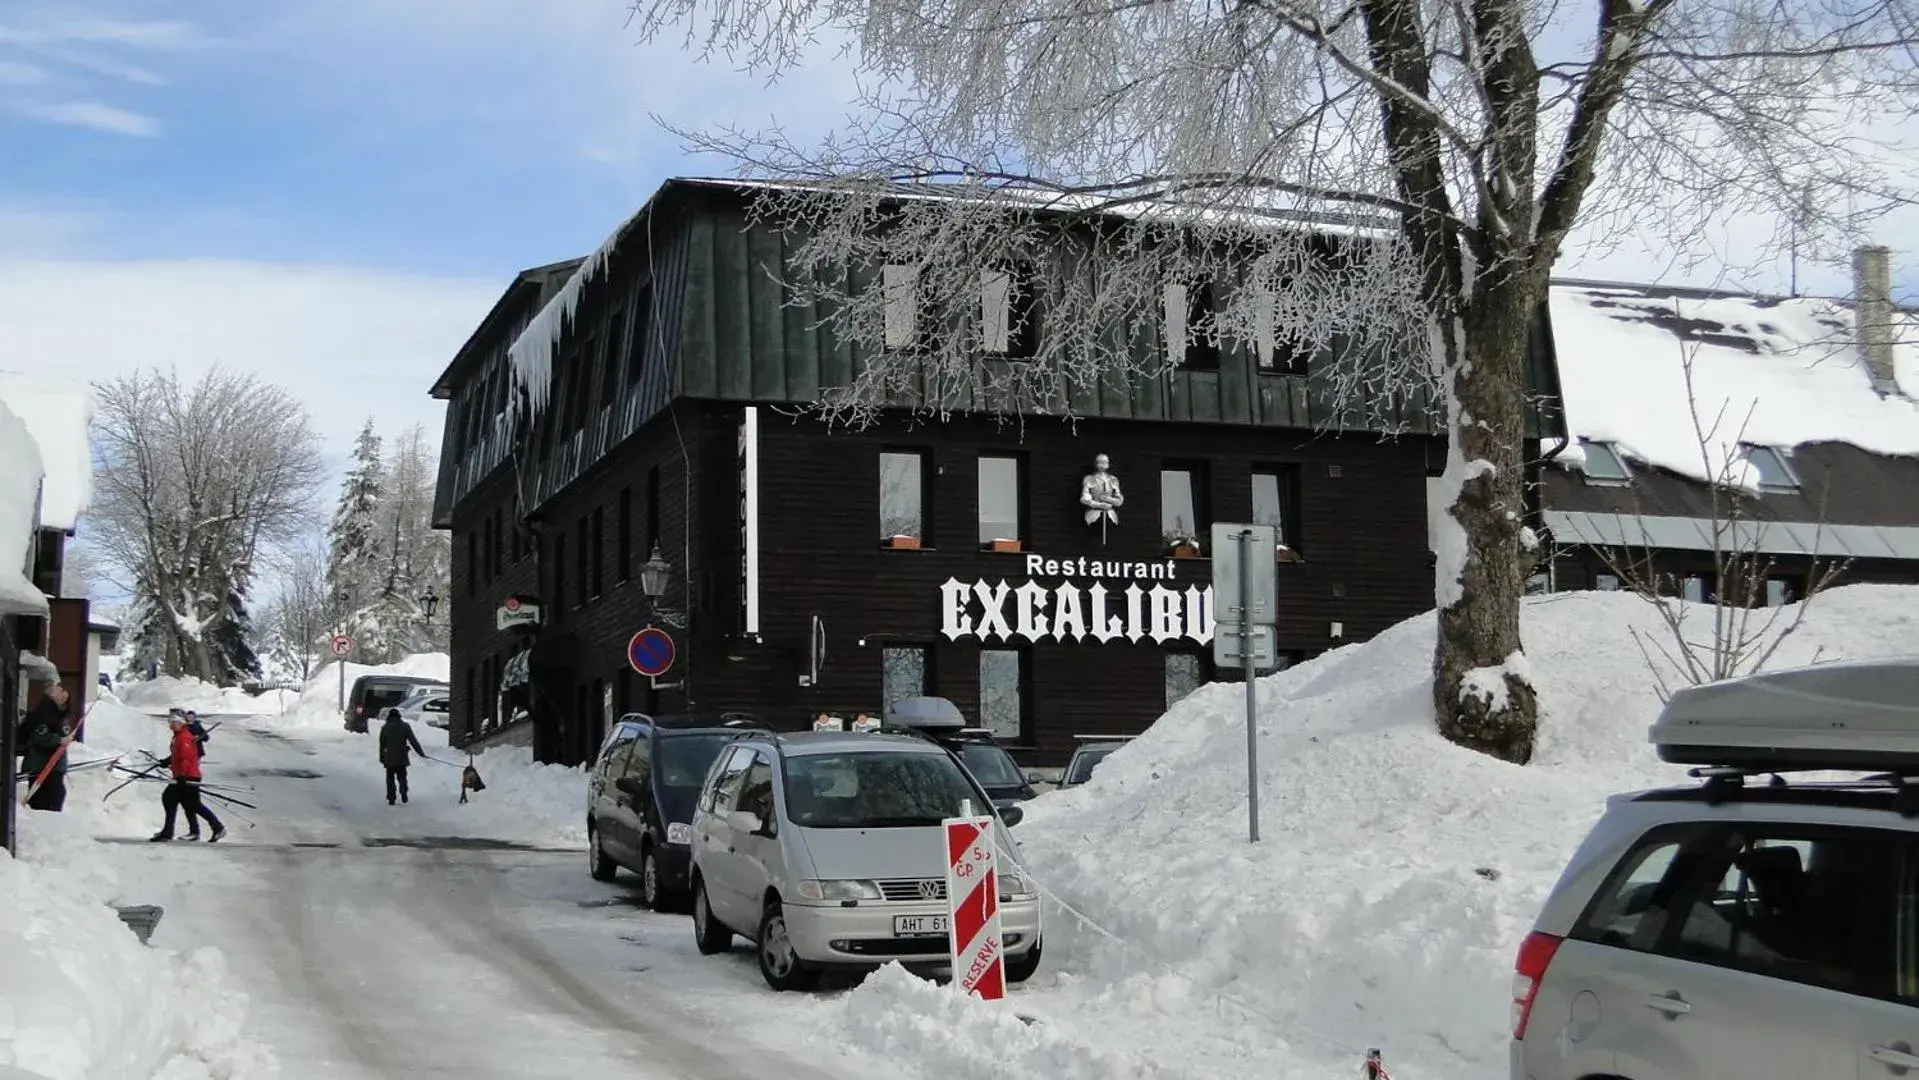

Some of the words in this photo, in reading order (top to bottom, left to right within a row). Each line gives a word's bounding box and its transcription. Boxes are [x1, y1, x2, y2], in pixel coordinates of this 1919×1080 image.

[1026, 554, 1176, 579] Restaurant
[939, 576, 1214, 646] EXCALIBU
[902, 918, 923, 930] AHT
[933, 918, 947, 930] 61
[962, 936, 998, 989] RESERVE
